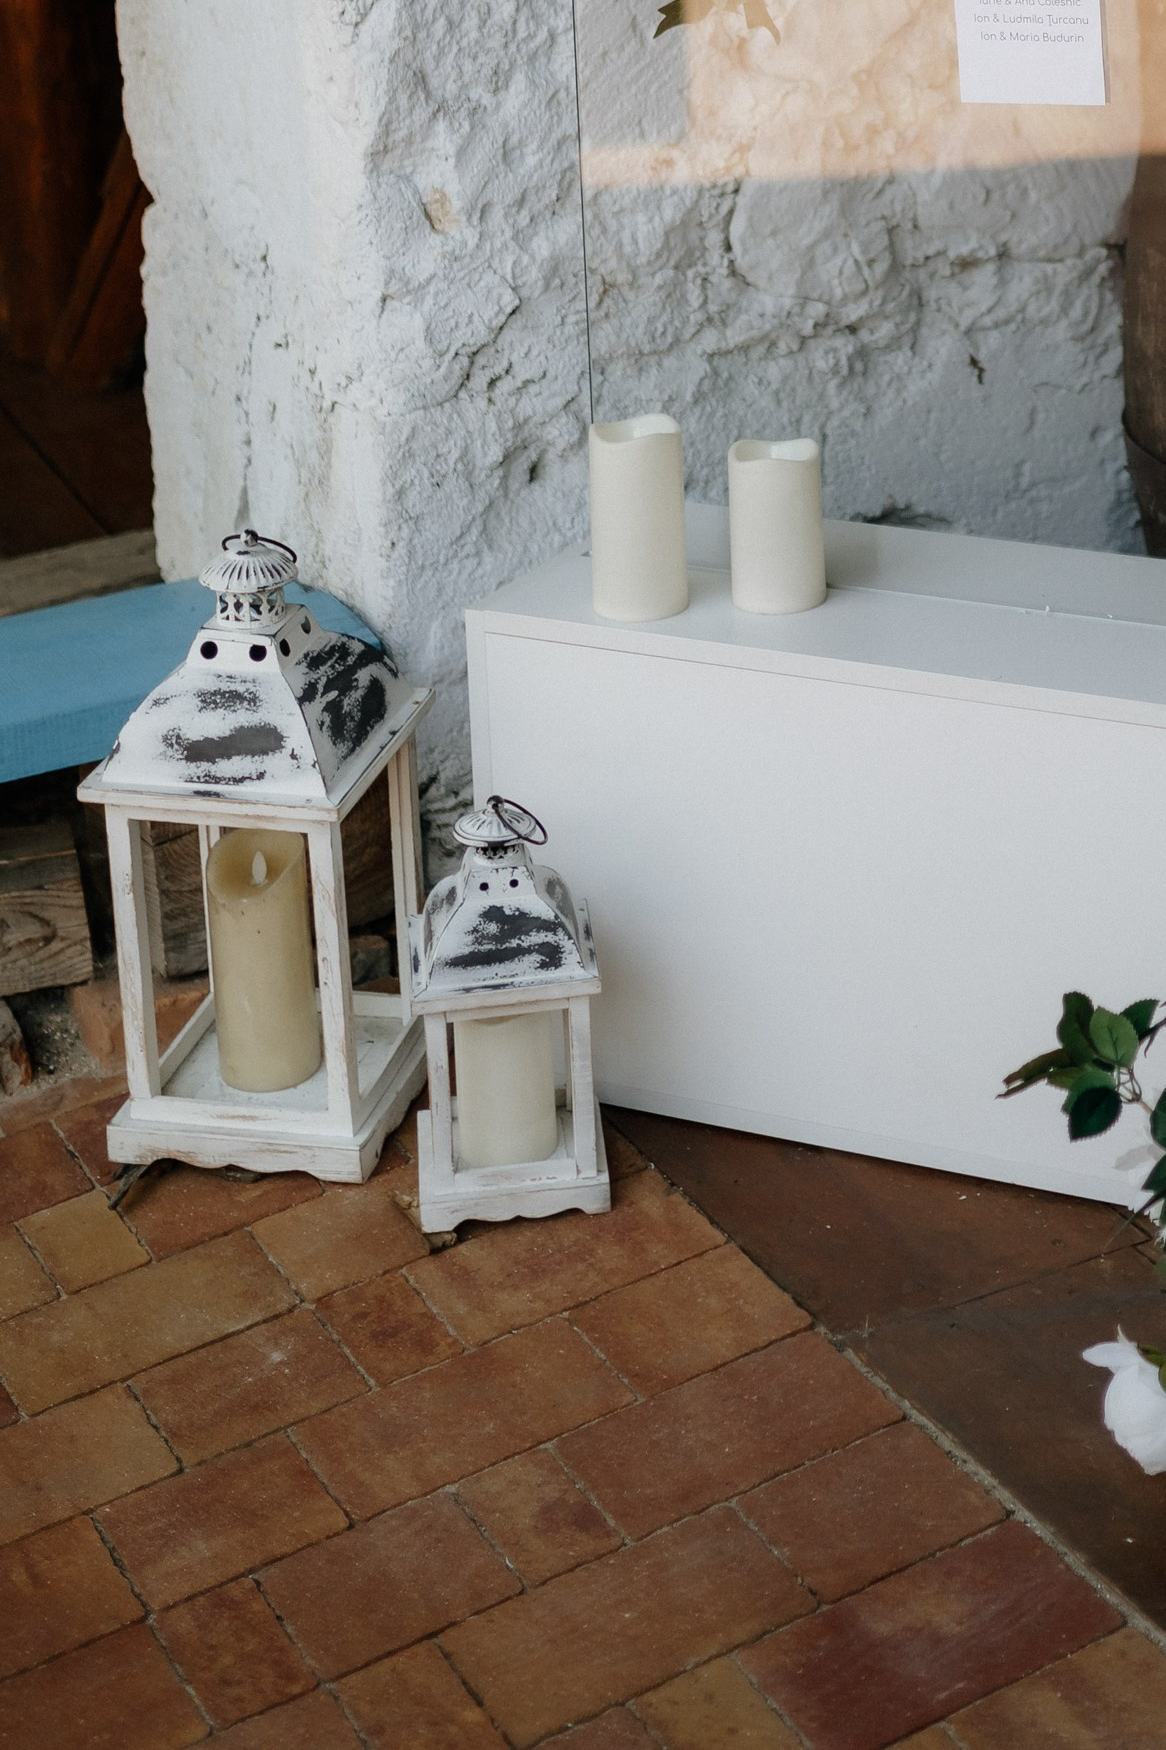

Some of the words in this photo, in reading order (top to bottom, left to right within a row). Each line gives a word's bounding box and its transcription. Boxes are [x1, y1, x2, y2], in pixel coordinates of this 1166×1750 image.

[973, 13, 990, 23] Ion
[992, 14, 1000, 23] &
[1003, 14, 1044, 24] Ludmila
[980, 31, 997, 41] Ion
[999, 31, 1007, 41] &
[1009, 32, 1040, 42] Maria
[1042, 33, 1085, 43] Budurin
